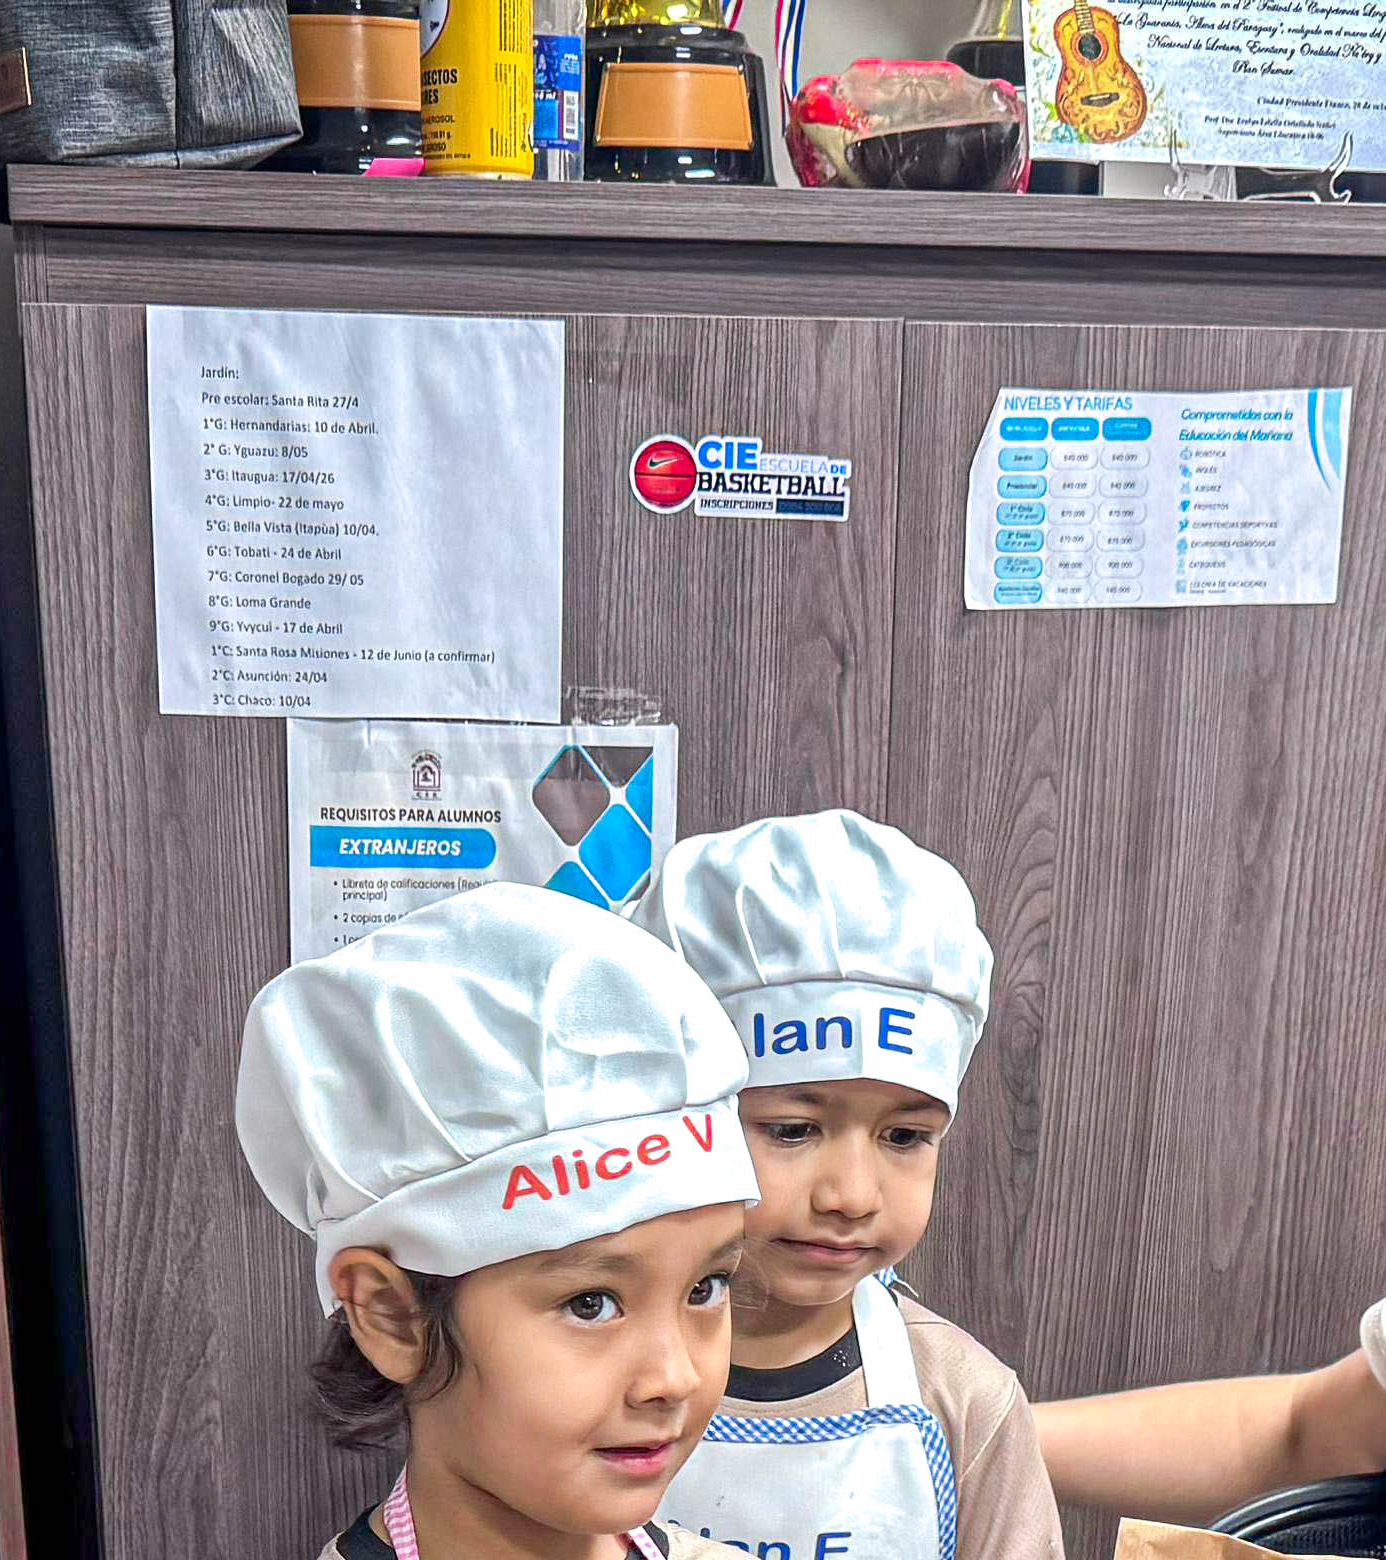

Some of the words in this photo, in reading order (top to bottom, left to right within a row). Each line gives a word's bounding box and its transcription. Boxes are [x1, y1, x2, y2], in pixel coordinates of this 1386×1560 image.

[202, 392, 220, 404] Pre
[224, 393, 269, 406] escolar:
[271, 394, 303, 407] Santa
[307, 396, 329, 408] Rita
[332, 396, 359, 410] 27/4
[1004, 396, 1061, 411] NIVELES
[1064, 396, 1073, 411] Y
[1075, 396, 1133, 411] TARIFAS
[230, 418, 311, 432] Hernandarias:
[315, 420, 327, 432] 10
[331, 420, 345, 433] de
[348, 422, 379, 434] Abril.
[1179, 429, 1231, 442] Educación
[1233, 429, 1248, 442] del
[1249, 429, 1293, 442] Mañana
[281, 446, 308, 459] 8/05
[698, 440, 758, 471] CIE
[830, 463, 847, 476] DE
[282, 471, 335, 484] 17/04/26
[696, 471, 845, 498] BASKETBALL
[278, 497, 292, 508] 22
[295, 497, 310, 509] de
[313, 500, 344, 512] mayo
[700, 498, 774, 512] INSCRIPCIONES
[233, 521, 261, 533] Bella
[264, 522, 292, 534] Vista
[281, 547, 294, 558] 24
[298, 547, 312, 559] de
[315, 548, 341, 561] Abril
[235, 571, 279, 584] Coronel
[282, 572, 325, 586] Bogado
[236, 596, 267, 608] Loma
[269, 597, 311, 609] Grande
[283, 622, 296, 634] 17
[299, 622, 313, 634] de
[316, 623, 343, 635] Abril
[236, 646, 268, 658] Santa
[270, 647, 297, 658] Rosa
[300, 647, 349, 660] Misiones
[360, 649, 374, 661] 12
[377, 649, 391, 661] de
[393, 649, 422, 662] Junio
[424, 650, 435, 663] (a
[438, 651, 495, 664] confirmar)
[295, 671, 327, 684] 24/04
[238, 694, 275, 707] Chaco:
[279, 695, 311, 708] 10/04
[320, 807, 396, 822] REQUISITOS
[399, 808, 434, 822] PARA
[438, 809, 502, 823] ALUMNOS
[339, 838, 461, 857] EXTRANJEROS
[342, 878, 373, 890] Libreta
[377, 879, 389, 890] de
[391, 878, 455, 890] calificaciones
[342, 889, 388, 902] principal)
[342, 913, 348, 923] 2
[351, 913, 382, 925] copias
[385, 912, 397, 923] de
[878, 1007, 916, 1055] E
[502, 1133, 671, 1212] Alice
[681, 1113, 714, 1153] V
